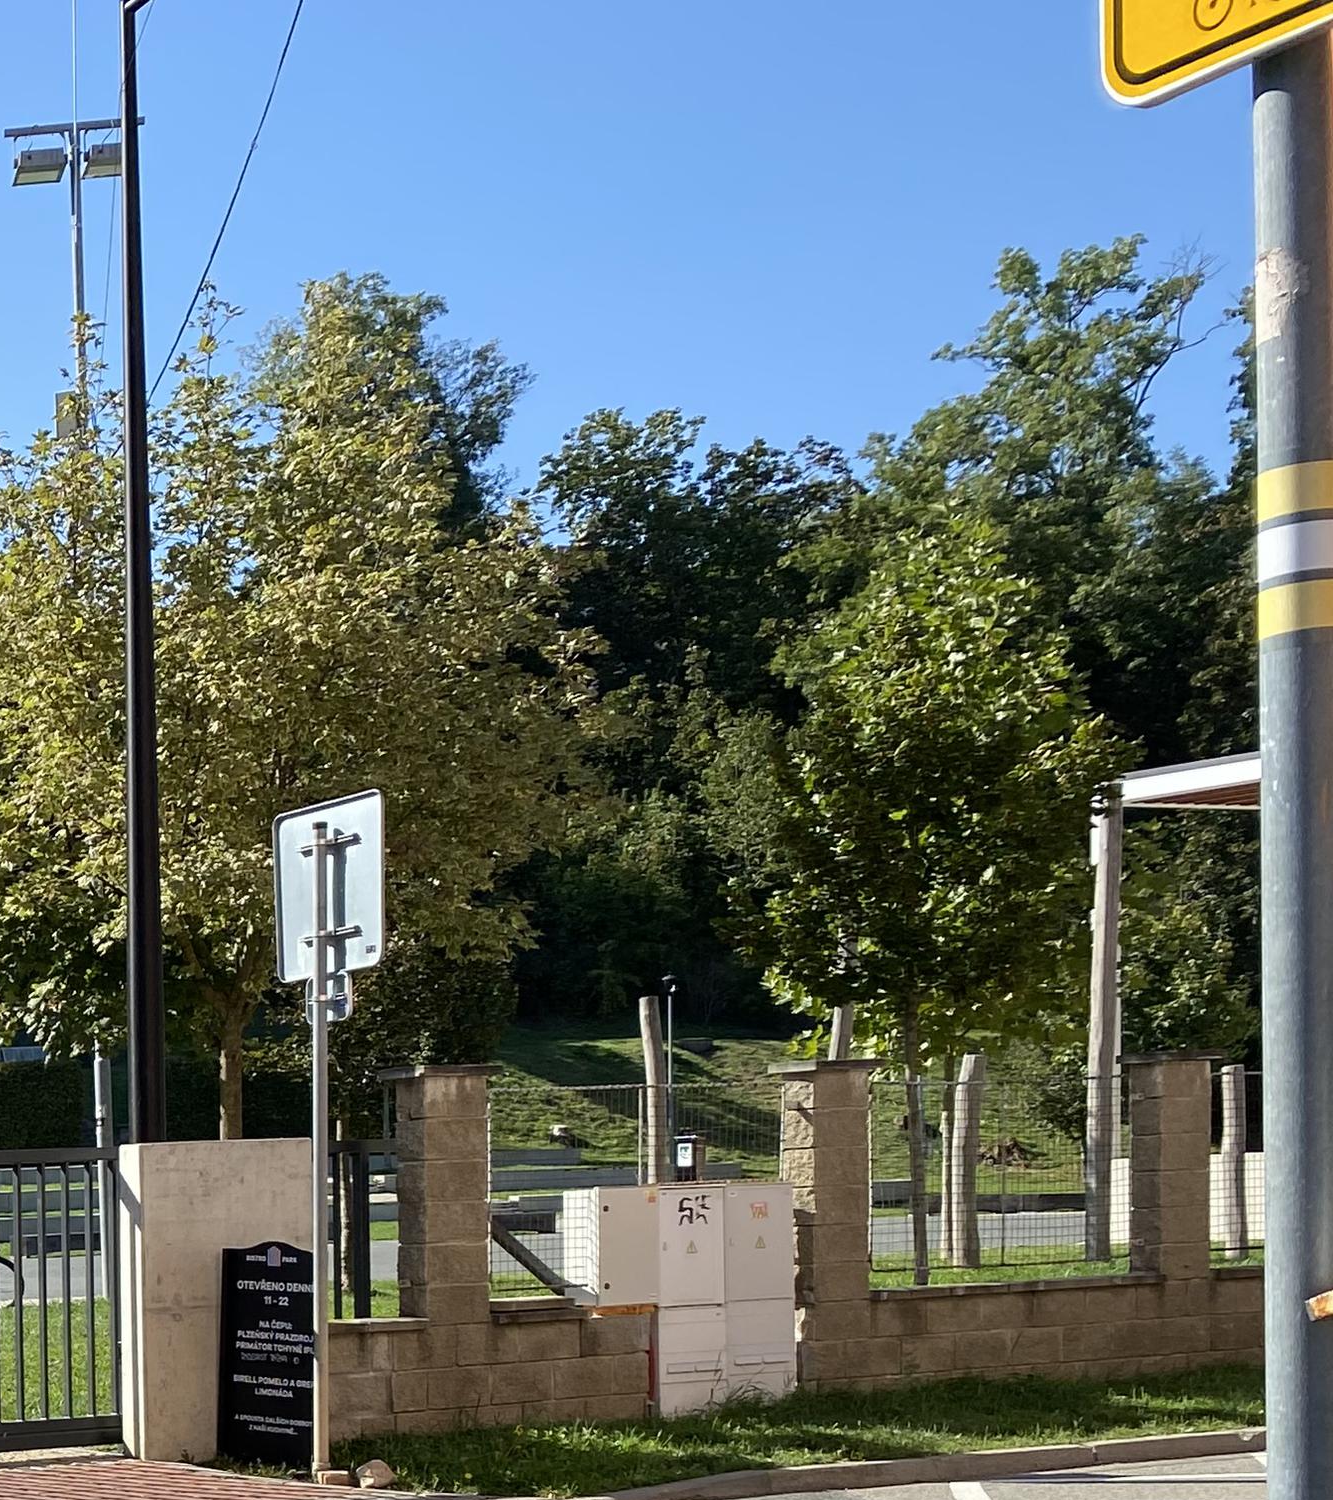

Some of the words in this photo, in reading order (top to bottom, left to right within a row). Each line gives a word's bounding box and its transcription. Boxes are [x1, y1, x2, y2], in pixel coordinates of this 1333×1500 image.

[236, 1278, 285, 1292] OTEVŘENO
[286, 1282, 314, 1293] DENN
[263, 1296, 272, 1305] 11
[278, 1296, 289, 1306] 22
[259, 1320, 270, 1328] NA
[271, 1319, 293, 1330] ČEPU:
[237, 1329, 274, 1340] PLZEŇSKÝ
[275, 1333, 314, 1343] PRAZDROJ
[236, 1340, 273, 1351] PRIMÁTOR
[233, 1374, 257, 1384] BIRELL
[258, 1376, 288, 1386] POMELO
[289, 1379, 295, 1387] A
[254, 1387, 294, 1398] LIMONÁDA
